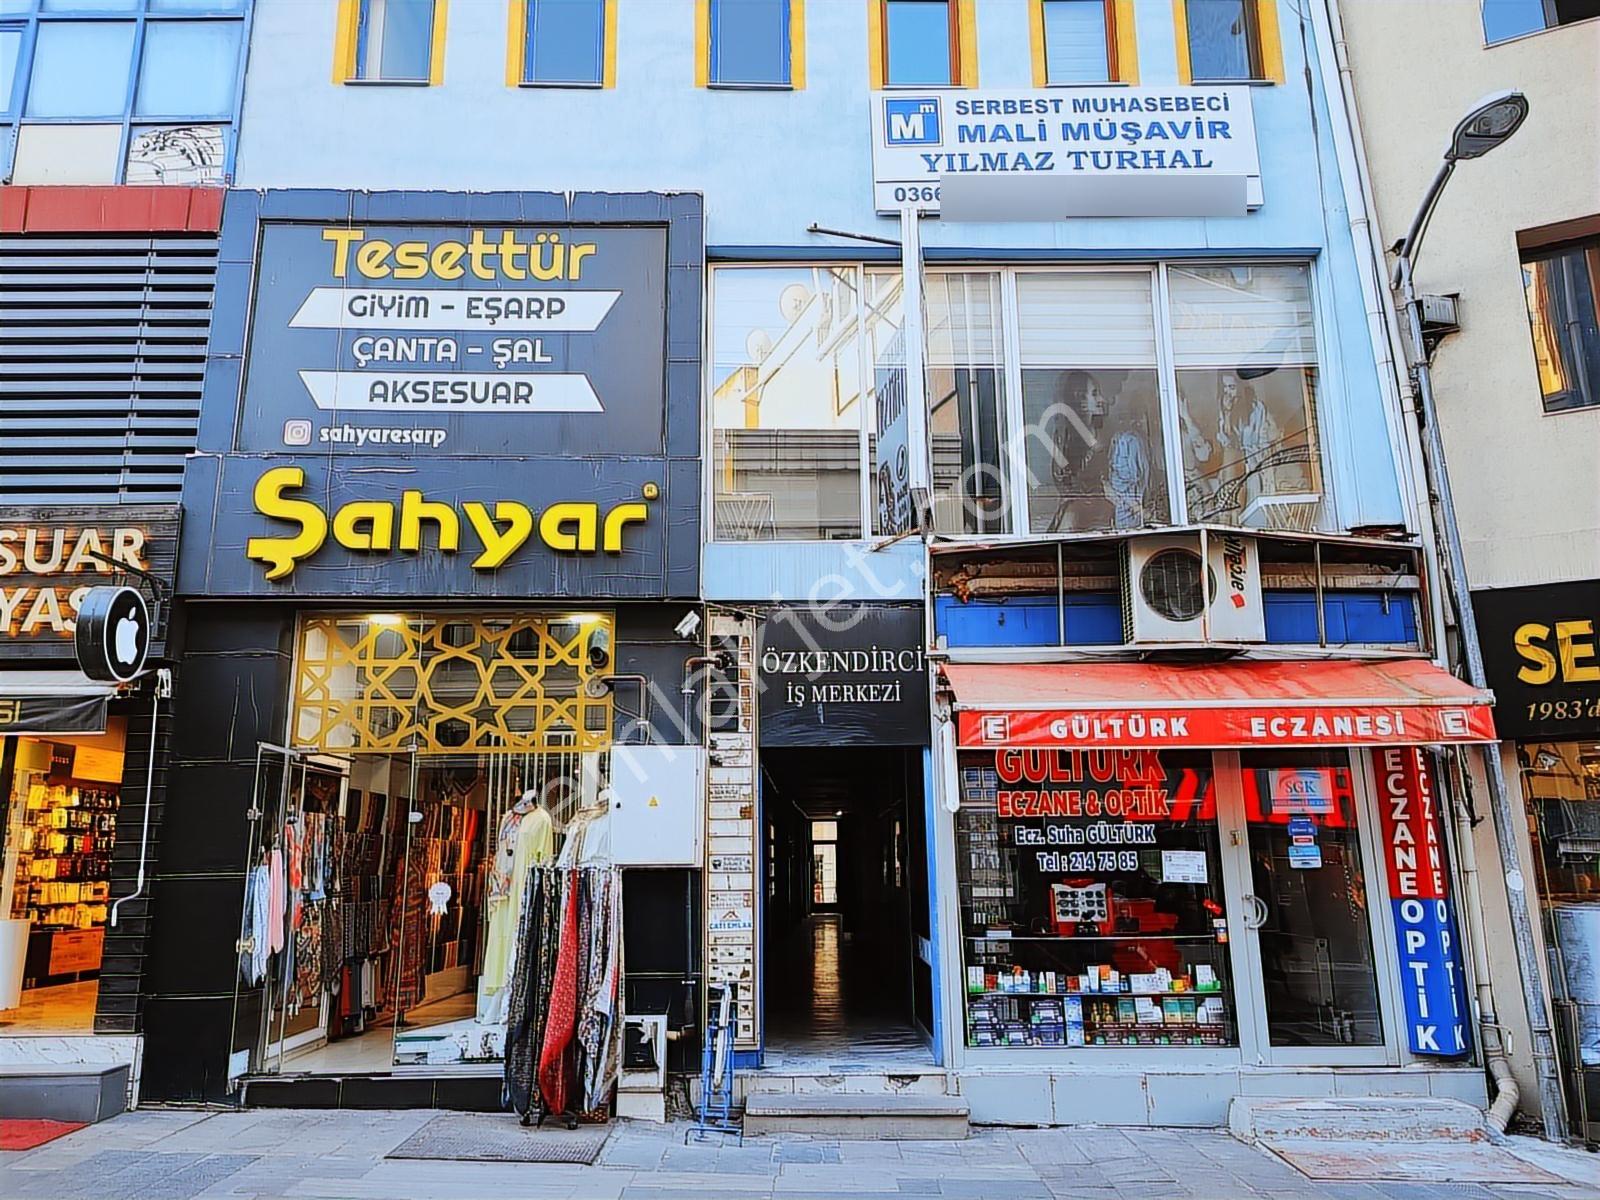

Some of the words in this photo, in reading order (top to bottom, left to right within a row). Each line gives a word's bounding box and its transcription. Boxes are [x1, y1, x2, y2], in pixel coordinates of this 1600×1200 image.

[955, 99, 1063, 116] SERBEST
[1072, 92, 1230, 114] MUHASEBECİ
[958, 118, 1047, 143] MALİ
[1062, 116, 1232, 145] MÜŞAVİR
[920, 152, 1055, 173] YILMAZ
[1066, 149, 1213, 171] TURHAL
[321, 228, 597, 282] Tesettür
[466, 296, 566, 325] EŞARP
[352, 336, 459, 369] ÇANTA
[491, 337, 553, 370] ŞAL
[368, 380, 534, 405] AKSESUAR
[319, 424, 447, 448] sahyaresarp
[246, 465, 649, 582] Şahyar
[762, 644, 924, 675] ÖZKENDİRCİ
[787, 681, 806, 707] İŞ
[811, 680, 901, 704] MERKEZİ
[1049, 714, 1190, 740] GÜLTÜRK
[1250, 710, 1406, 738] ECZANESİ
[1285, 780, 1316, 793] SGK
[997, 790, 1082, 819] ECZANE
[1085, 791, 1101, 817] &
[1105, 785, 1170, 817] OPTİK
[1014, 825, 1046, 845] Ecz.
[1046, 824, 1083, 845] Suha
[1087, 821, 1157, 845] GÜLTÜRK
[1385, 748, 1419, 896] ECZANE
[1415, 747, 1443, 895] ECZANE
[1037, 851, 1060, 872] Tel
[1070, 852, 1096, 871] 214
[1098, 852, 1116, 871] 75
[1119, 851, 1139, 871] 85
